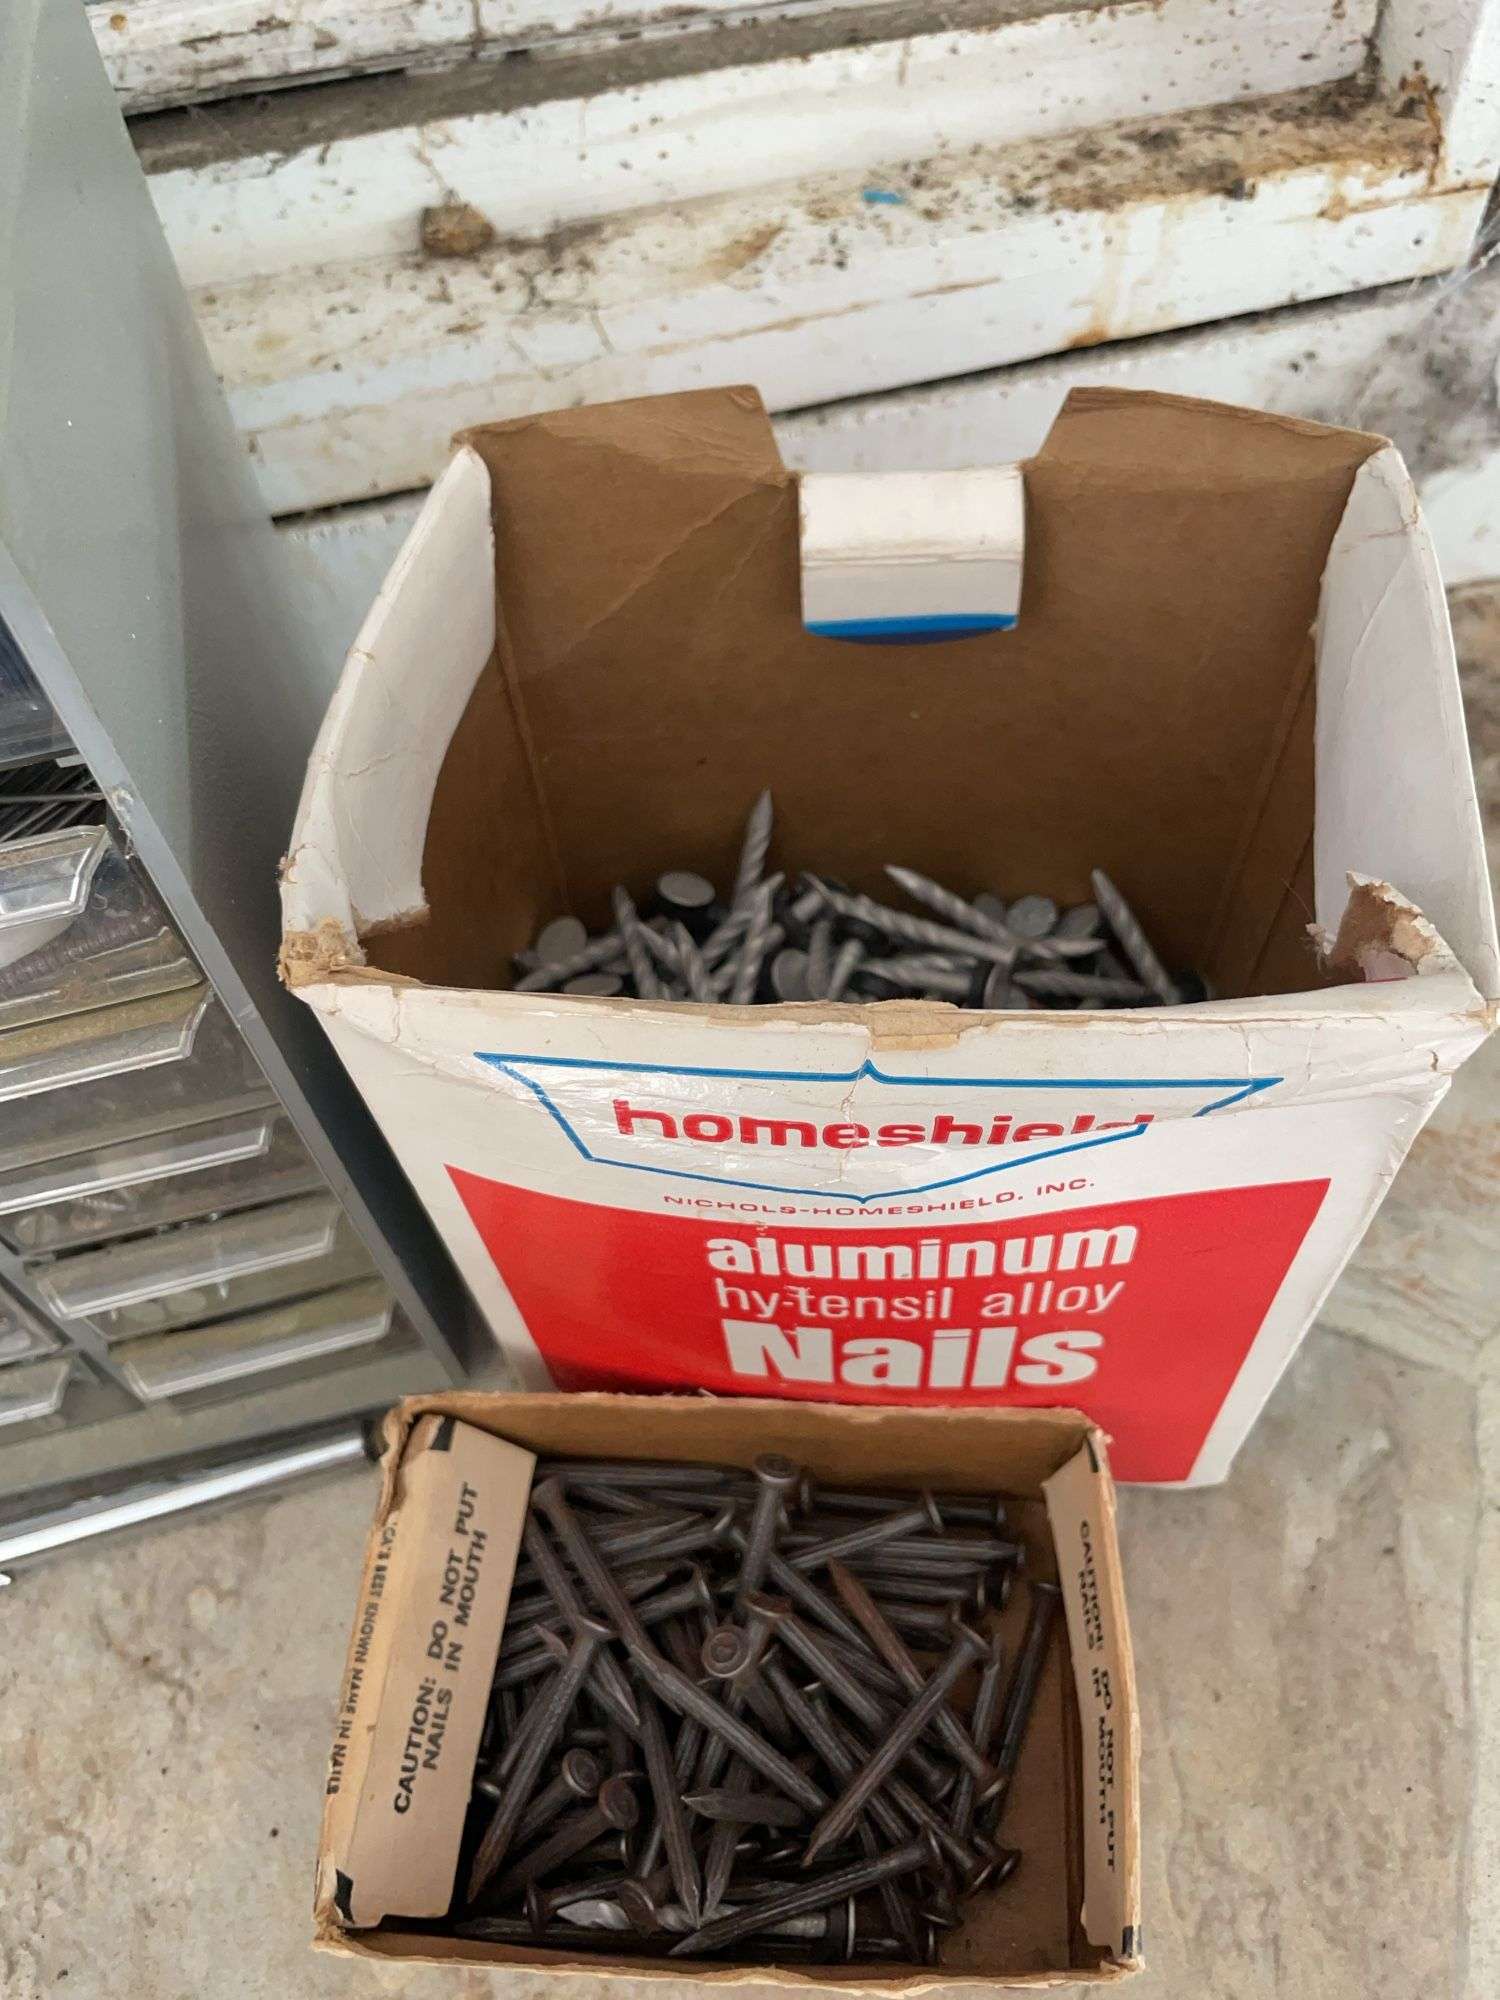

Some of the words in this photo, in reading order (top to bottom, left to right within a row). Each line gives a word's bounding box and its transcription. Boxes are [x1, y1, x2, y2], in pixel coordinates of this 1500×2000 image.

[1037, 1178, 1095, 1196] INC.
[706, 1223, 1138, 1280] aluminum
[716, 1278, 952, 1320] hy-tensil
[981, 1279, 1125, 1316] alloy
[722, 1319, 1105, 1388] Nails
[354, 1602, 378, 1664] KNOWN
[393, 1677, 437, 1813] CAUTION:
[427, 1620, 448, 1660] DO
[440, 1548, 463, 1605] NOT
[455, 1481, 478, 1535] PUT
[422, 1687, 453, 1770] NAILS
[444, 1642, 463, 1671] IN
[454, 1529, 487, 1627] MOUTH
[339, 1719, 353, 1738] IN
[1105, 1728, 1114, 1788] NOT
[1107, 1810, 1115, 1873] PUT
